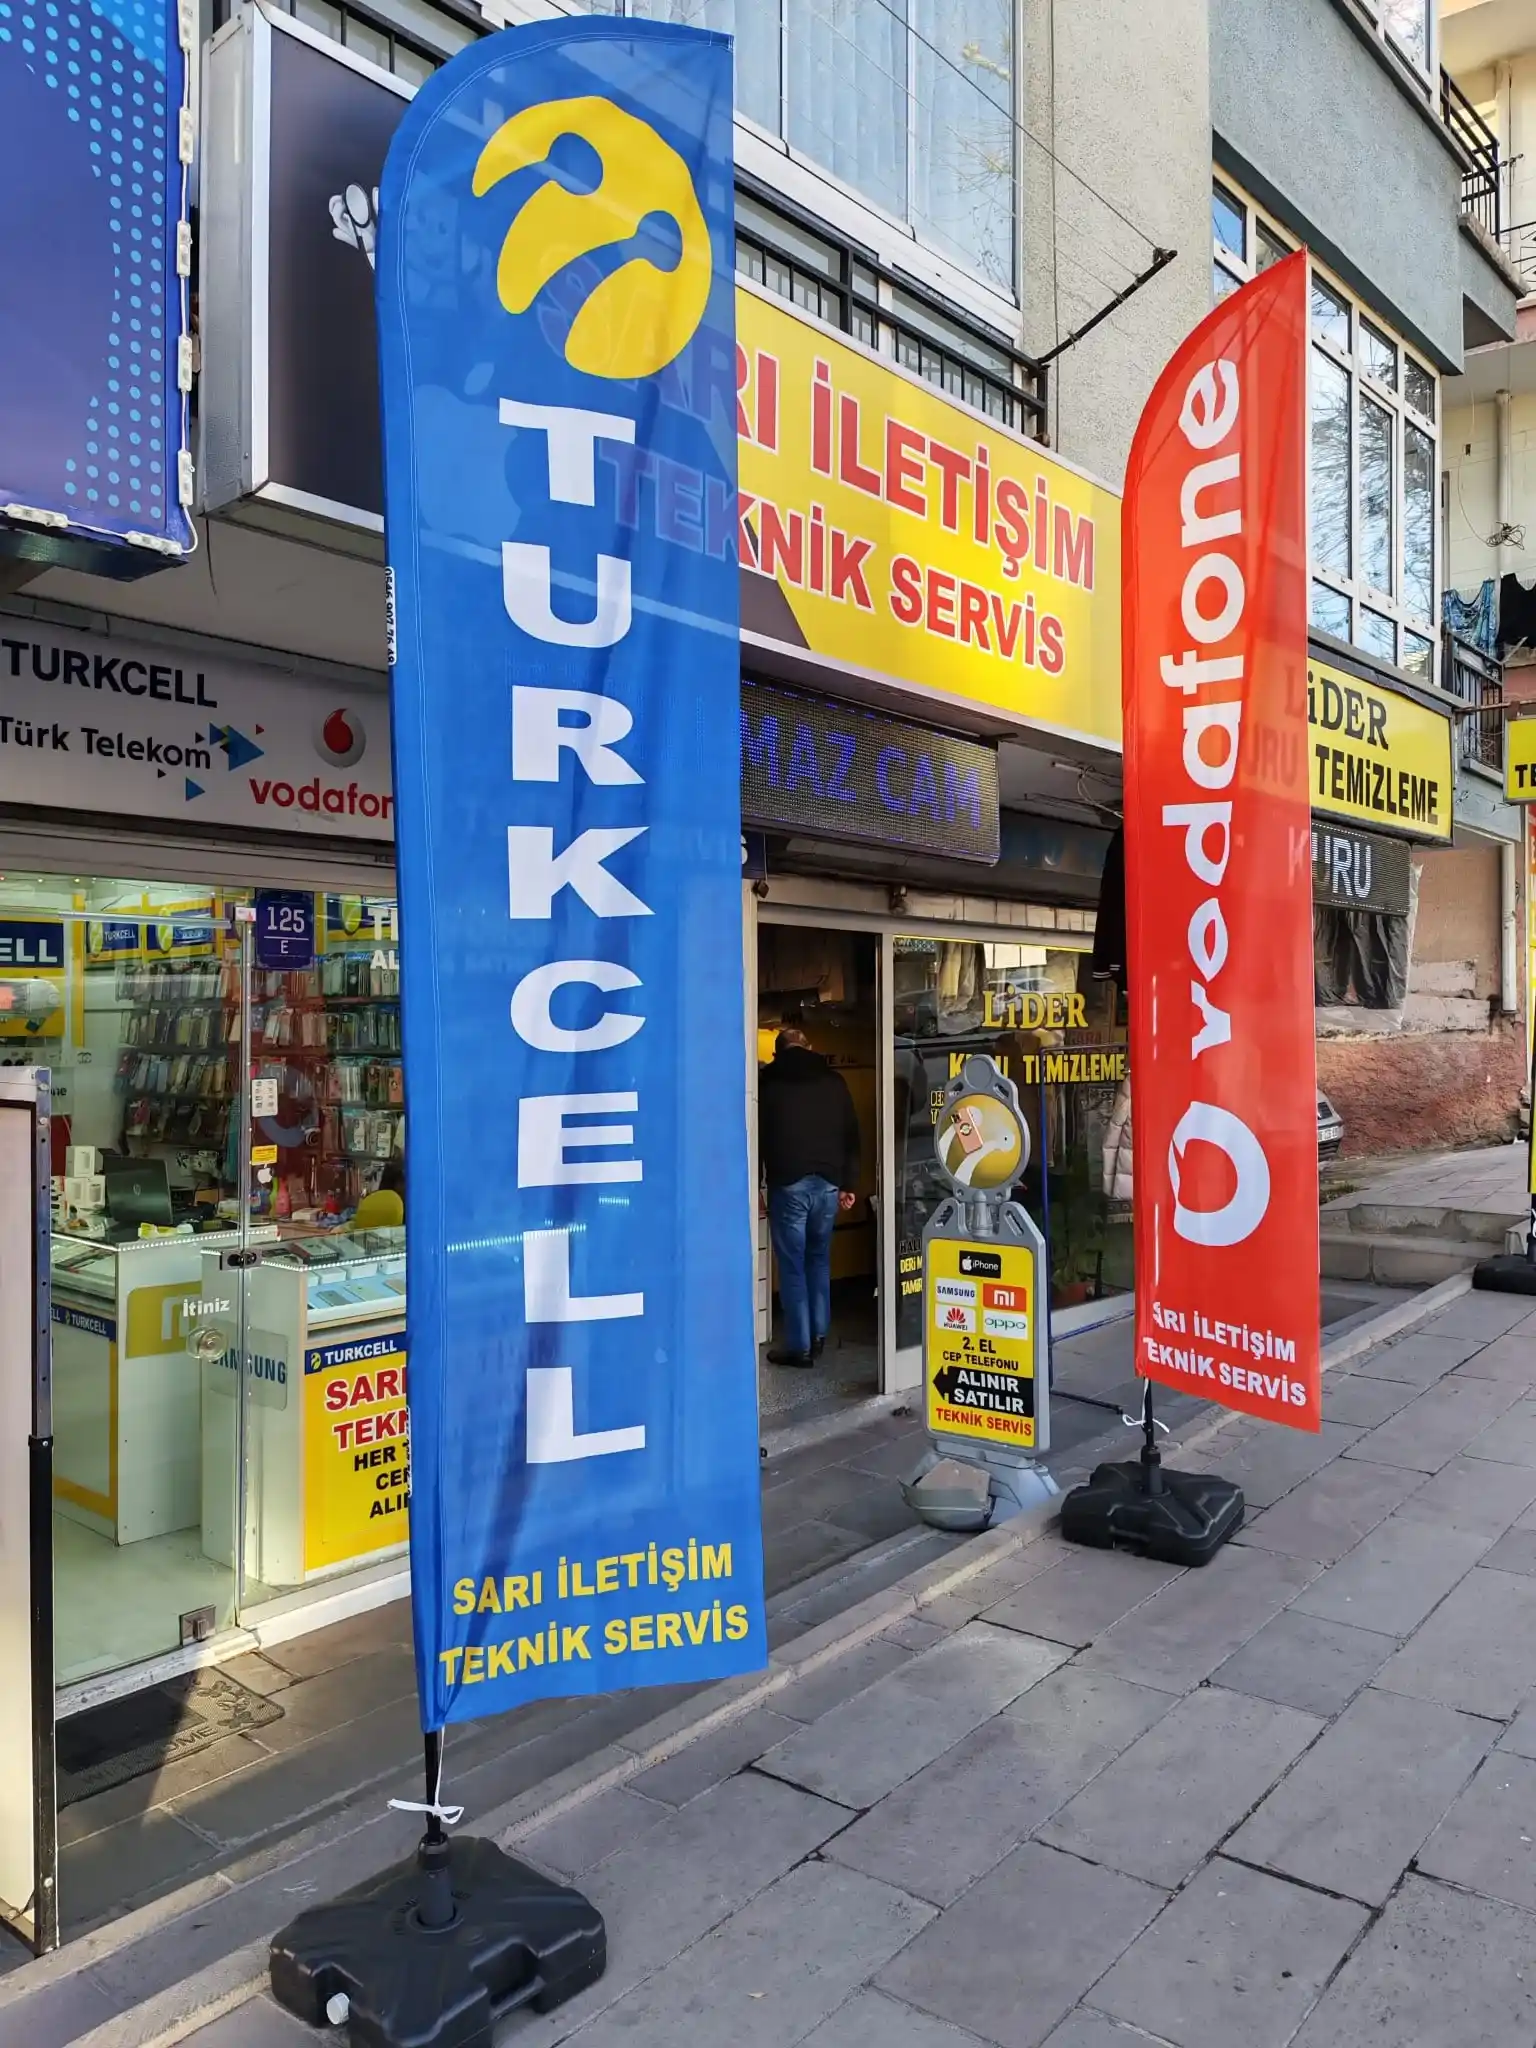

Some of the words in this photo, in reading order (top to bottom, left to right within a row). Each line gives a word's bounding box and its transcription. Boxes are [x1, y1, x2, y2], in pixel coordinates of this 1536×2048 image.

[811, 357, 1095, 592] İLETİŞİM
[889, 553, 1066, 678] SERVİS
[2, 638, 218, 708] TURKCELL
[1160, 358, 1245, 1060] vodafone
[0, 715, 70, 751] Türk
[81, 727, 211, 769] Telekom
[874, 744, 983, 830] CAM
[267, 906, 304, 933] 125
[499, 396, 653, 1464] TURKCELL
[280, 940, 289, 954] E
[972, 1260, 999, 1271] iPhone
[937, 1285, 975, 1298] SAMSUNG
[71, 1313, 107, 1335] TURKCELL
[943, 1322, 968, 1331] HUAWEI
[984, 1317, 1026, 1331] oppo
[1193, 1310, 1296, 1364] İLETİŞİM
[325, 1340, 397, 1365] TURKCELL
[962, 1336, 975, 1351] 2.
[979, 1338, 997, 1354] EL
[943, 1350, 962, 1362] CEP
[965, 1353, 1019, 1372] TELEFONU
[1143, 1336, 1216, 1380] TEKNİK
[1218, 1362, 1308, 1407] SERVİS
[957, 1369, 1020, 1394] ALINIR
[953, 1388, 1025, 1414] SATILIR
[936, 1407, 983, 1428] TEKNİK
[986, 1416, 1032, 1436] SERVİS
[354, 1445, 396, 1472] HER
[452, 1570, 542, 1615] SARI
[558, 1537, 732, 1592] İLETİŞİM
[439, 1621, 591, 1687] TEKNİK
[604, 1599, 749, 1656] SERVİS
